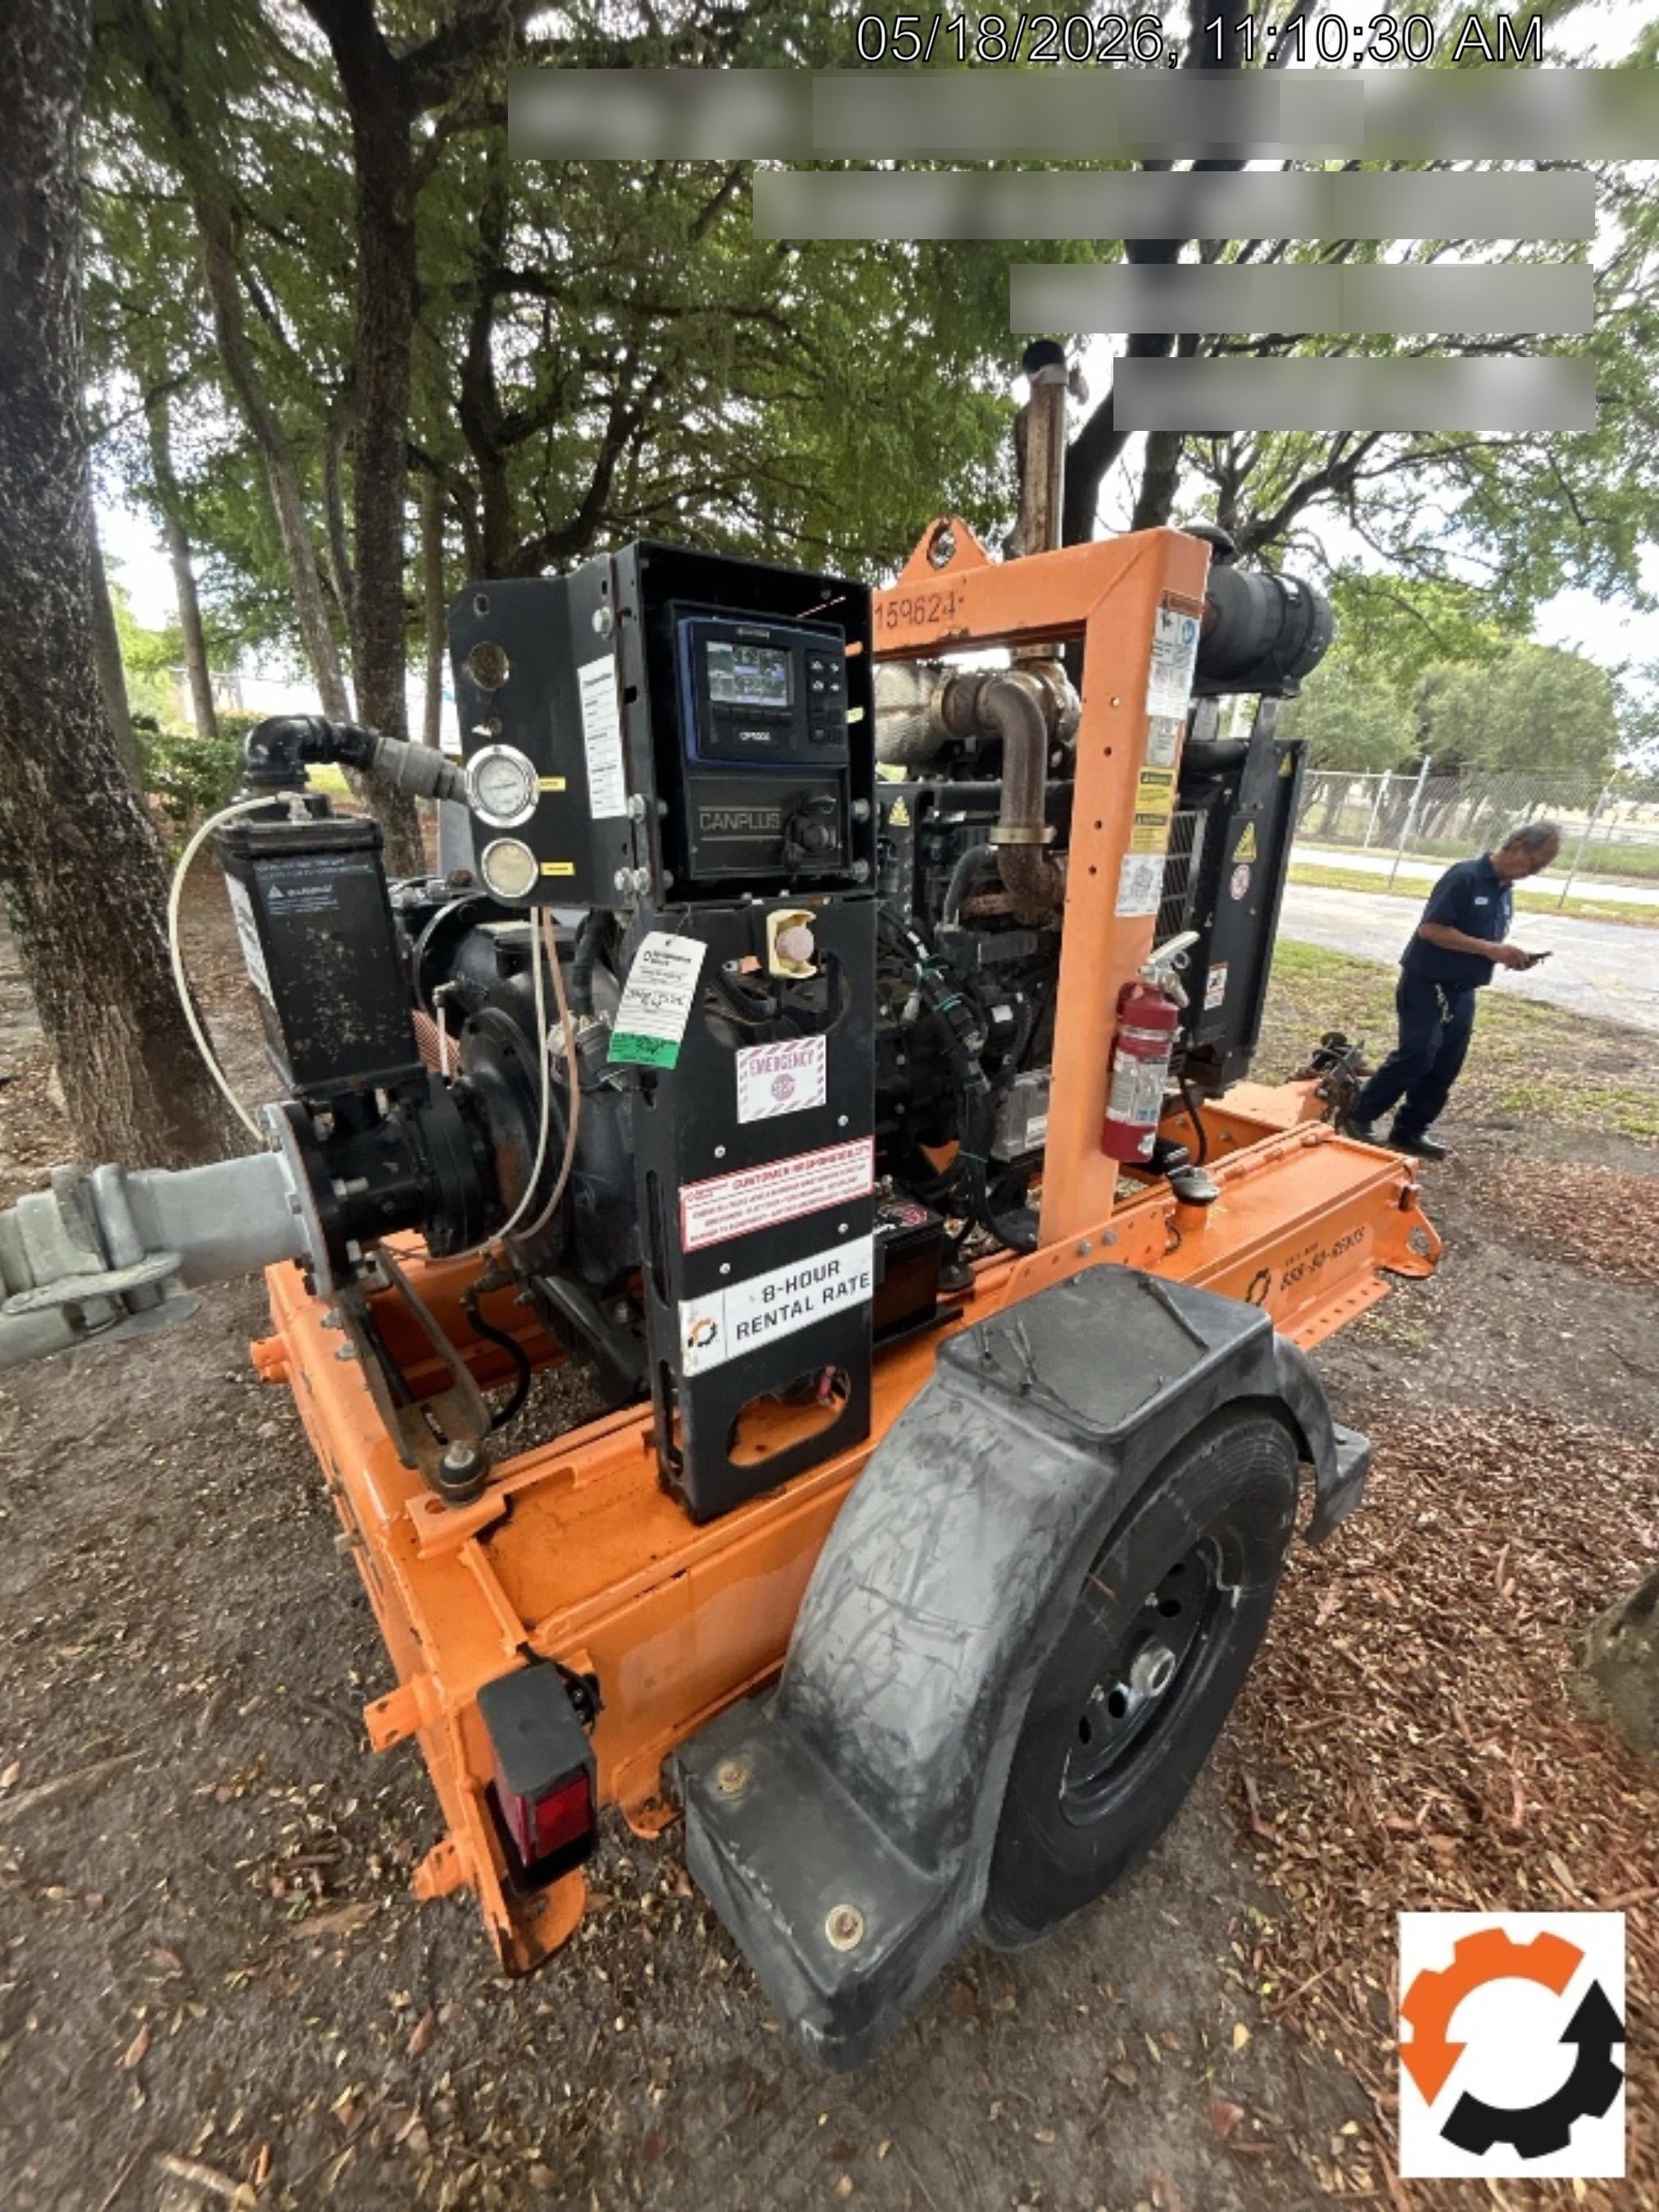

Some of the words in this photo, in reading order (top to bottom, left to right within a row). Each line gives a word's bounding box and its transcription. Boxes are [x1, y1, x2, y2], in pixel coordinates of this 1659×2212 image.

[700, 812, 781, 831] CANPLUS
[749, 1049, 814, 1077] EMERGENCY
[761, 1259, 841, 1303] 8-HOUR
[737, 1296, 814, 1340] RENTAL
[822, 1271, 871, 1304] RATE
